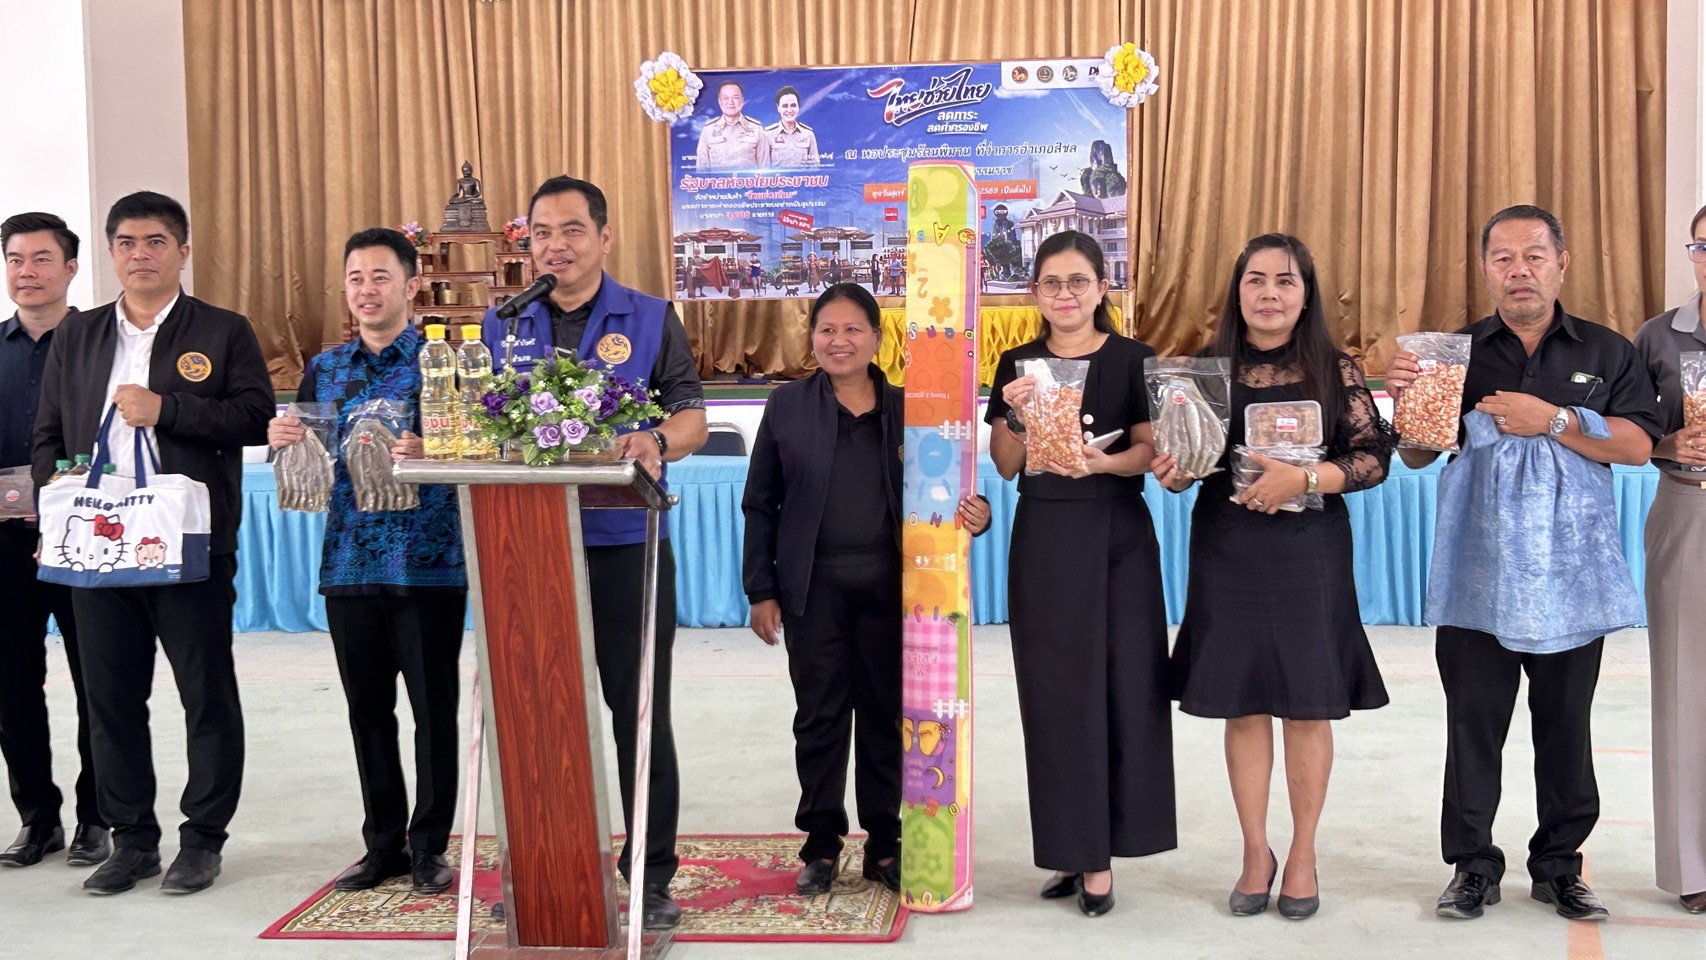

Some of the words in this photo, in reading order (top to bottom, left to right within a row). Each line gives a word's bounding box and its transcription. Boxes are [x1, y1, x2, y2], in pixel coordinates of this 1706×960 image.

[937, 110, 979, 121] ลดภาระ
[926, 122, 989, 133] ลดค่าครองชีพ
[975, 140, 1078, 157] ที่ว่าการอำเภอสีชล
[680, 172, 830, 193] รัฐบาลห่วงใยประชาชน
